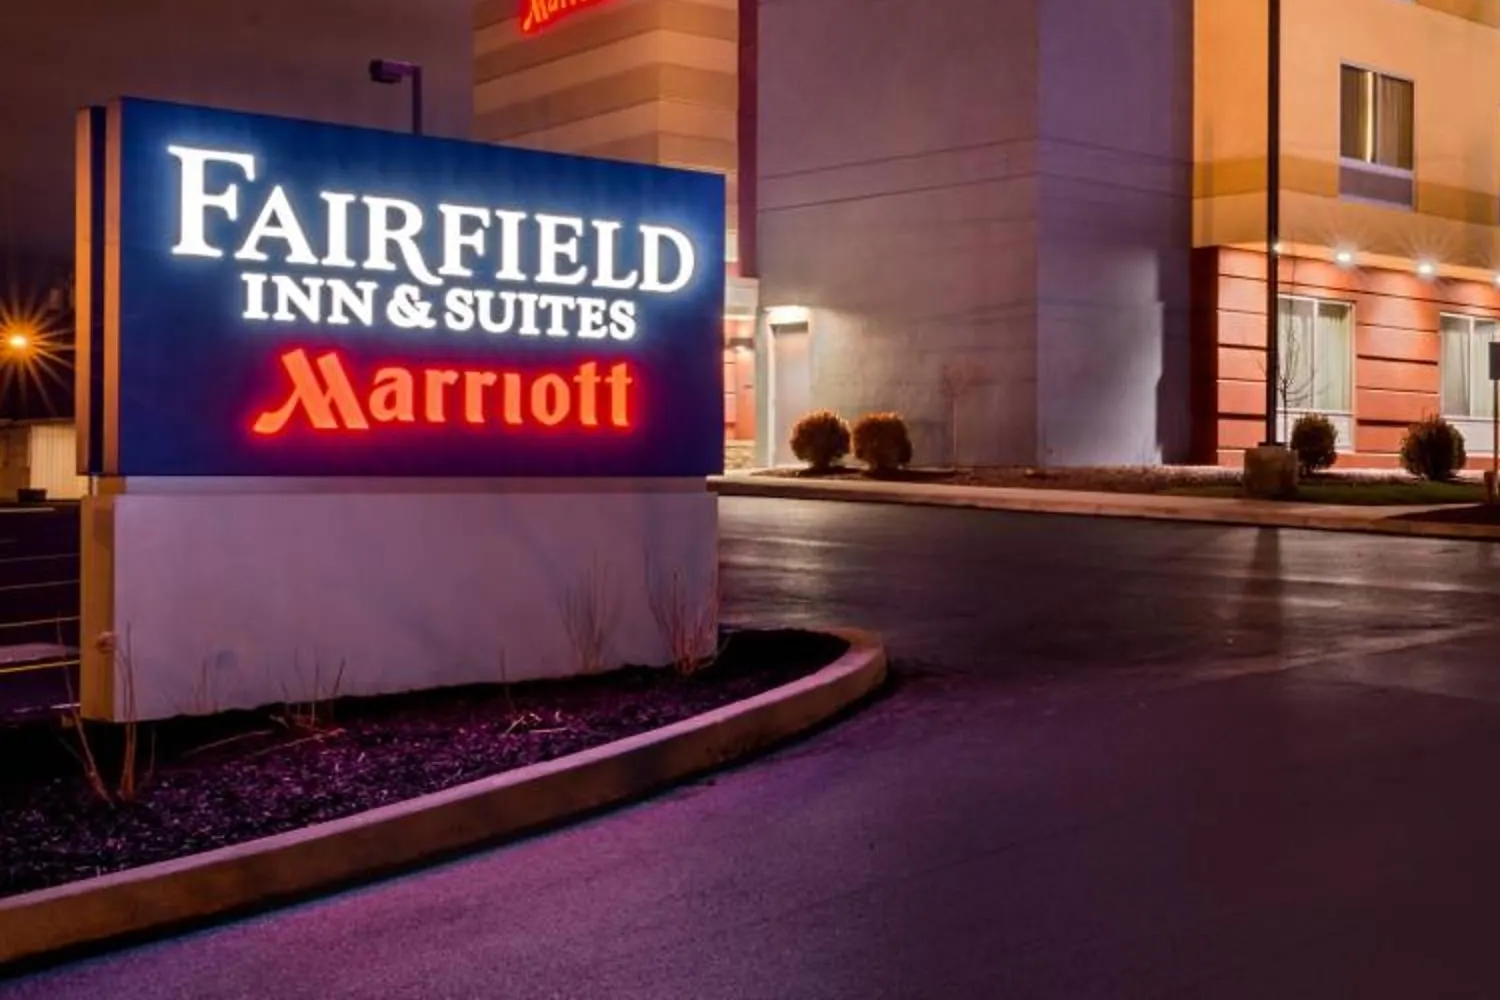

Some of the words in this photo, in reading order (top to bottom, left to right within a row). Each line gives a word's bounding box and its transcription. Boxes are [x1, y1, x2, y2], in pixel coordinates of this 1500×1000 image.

[167, 145, 695, 293] FAIRFIELD
[241, 272, 379, 326] INN
[386, 283, 437, 329] &
[444, 287, 637, 341] SUITES
[252, 348, 633, 434] Marriott
